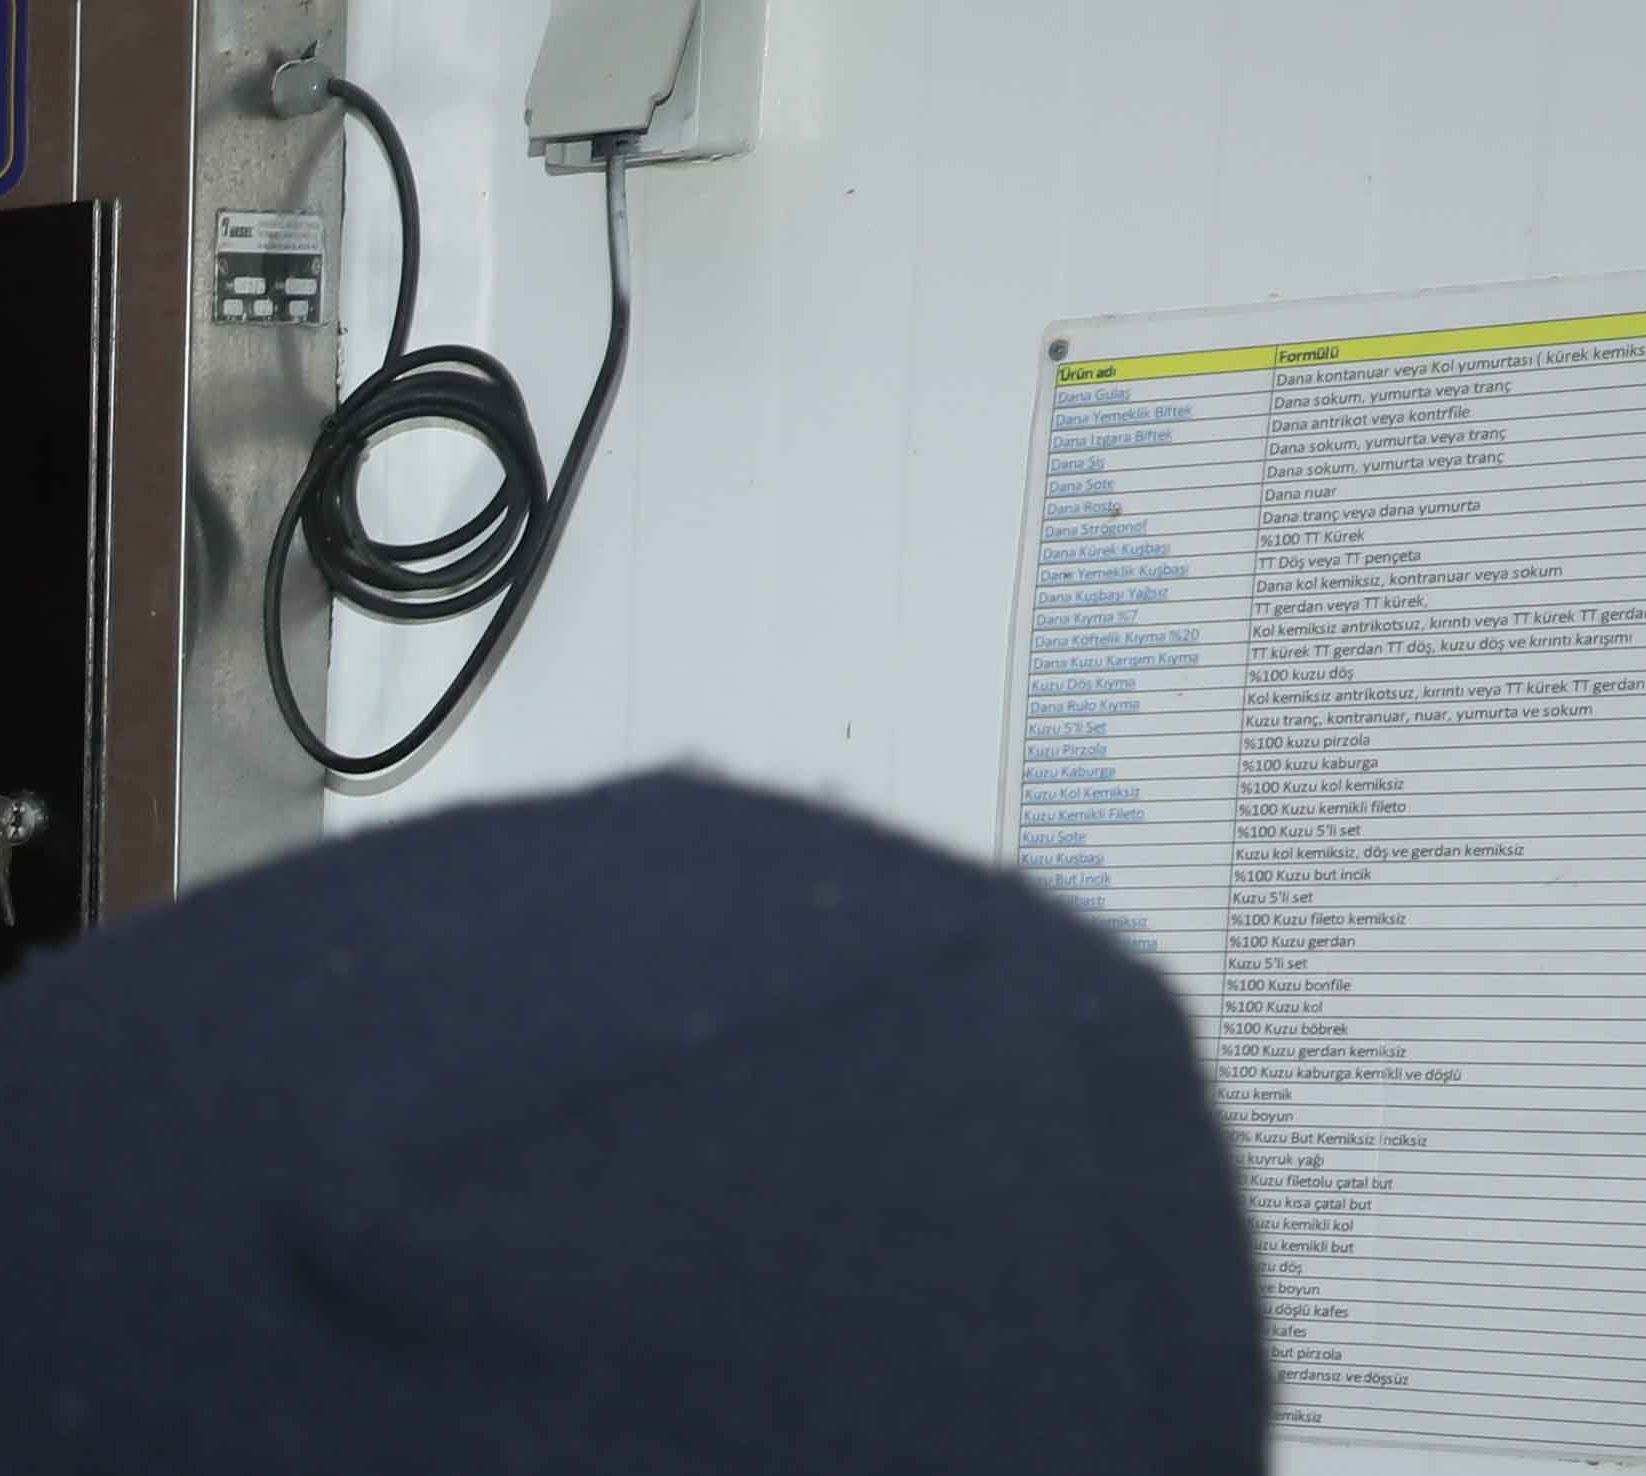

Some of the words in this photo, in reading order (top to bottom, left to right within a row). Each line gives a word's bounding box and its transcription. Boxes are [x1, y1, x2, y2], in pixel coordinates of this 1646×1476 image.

[1278, 345, 1339, 363] Formülü
[1059, 366, 1093, 382] Ürün
[1276, 373, 1313, 386] Dana
[1316, 367, 1390, 383] kontanuar
[1394, 364, 1428, 378] veya
[1431, 358, 1454, 374] Kol
[1456, 355, 1532, 375] yumurtası
[1546, 348, 1591, 365] kürek
[1274, 396, 1310, 410] Dana
[1313, 392, 1365, 408] sokum,
[1370, 386, 1432, 406] yumurta
[1435, 384, 1470, 402] veya
[1473, 381, 1511, 399] tranç
[1272, 419, 1308, 433] Dana
[1311, 413, 1368, 430] antrikot
[1371, 413, 1405, 428] veya
[1264, 488, 1301, 502] Dana
[1304, 487, 1337, 499] nuar
[1263, 511, 1299, 524] Dana
[1303, 510, 1340, 523] tranç
[1343, 507, 1376, 521] veya
[1379, 503, 1415, 518] dana
[1417, 500, 1481, 519] yumurta
[1261, 532, 1300, 548] %100
[1303, 531, 1322, 545] TT
[1324, 528, 1364, 544] Kürek
[1258, 556, 1276, 569] TT
[1278, 556, 1305, 572] Döş
[1308, 555, 1340, 571] veya
[1344, 551, 1362, 564] TT
[1364, 550, 1421, 569] pençeta
[1257, 580, 1292, 592] Dana
[1296, 576, 1318, 591] kol
[1389, 571, 1471, 586] kontranuar
[1474, 568, 1508, 585] veya
[1511, 564, 1563, 579] sokum
[1254, 601, 1272, 614] TT
[1274, 599, 1323, 617] gerdan
[1327, 600, 1360, 614] veya
[1362, 595, 1382, 609] TT
[1249, 668, 1289, 683] %100
[1292, 668, 1326, 681] kuzu
[1329, 665, 1354, 684] döş
[1243, 735, 1283, 750] %100
[1286, 735, 1320, 748] kuzu
[1323, 733, 1370, 752] pirzola
[1241, 758, 1282, 772] %100
[1284, 759, 1318, 771] kuzu
[1321, 756, 1378, 773] kaburga
[1239, 780, 1280, 794] %100
[1283, 780, 1317, 793] Kuzu
[1321, 778, 1342, 793] kol
[1238, 803, 1278, 817] %100
[1281, 804, 1317, 816] Kuzu
[1319, 800, 1368, 815] kemikli
[1370, 800, 1406, 813] fileto
[1236, 825, 1276, 839] %100
[1279, 825, 1313, 838] Kuzu
[1316, 823, 1337, 837] 5'li
[1340, 824, 1361, 837] set
[1234, 849, 1269, 860] Kuzu
[1272, 846, 1293, 860] kol
[1363, 845, 1388, 862] döş
[1392, 847, 1409, 858] ve
[1411, 843, 1461, 861] gerdan
[1233, 870, 1273, 882] %100
[1276, 869, 1310, 882] Kuzu
[1314, 868, 1337, 881] but
[1340, 867, 1371, 881] incik
